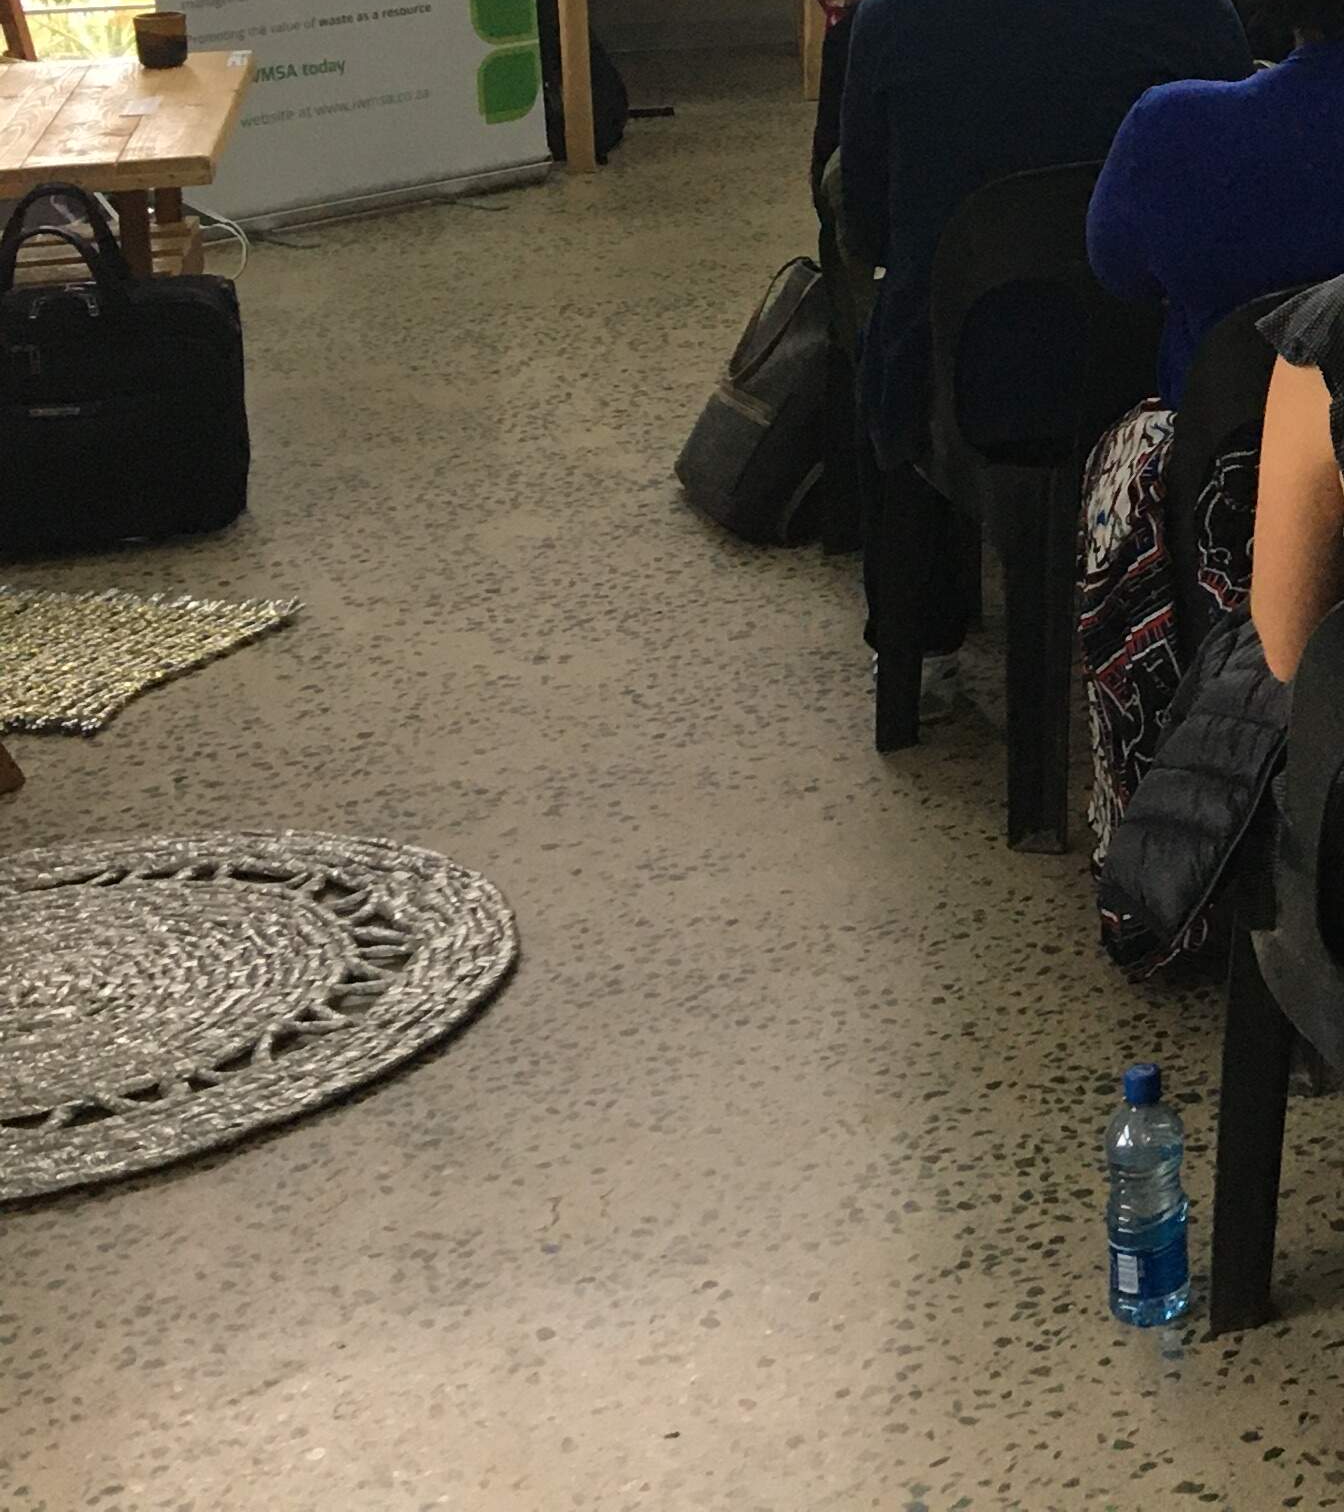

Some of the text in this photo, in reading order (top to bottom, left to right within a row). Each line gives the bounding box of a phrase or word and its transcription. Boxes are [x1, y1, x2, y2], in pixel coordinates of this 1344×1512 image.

[319, 12, 354, 27] waste
[357, 11, 370, 23] as
[382, 3, 431, 19] resource
[302, 58, 346, 78] today
